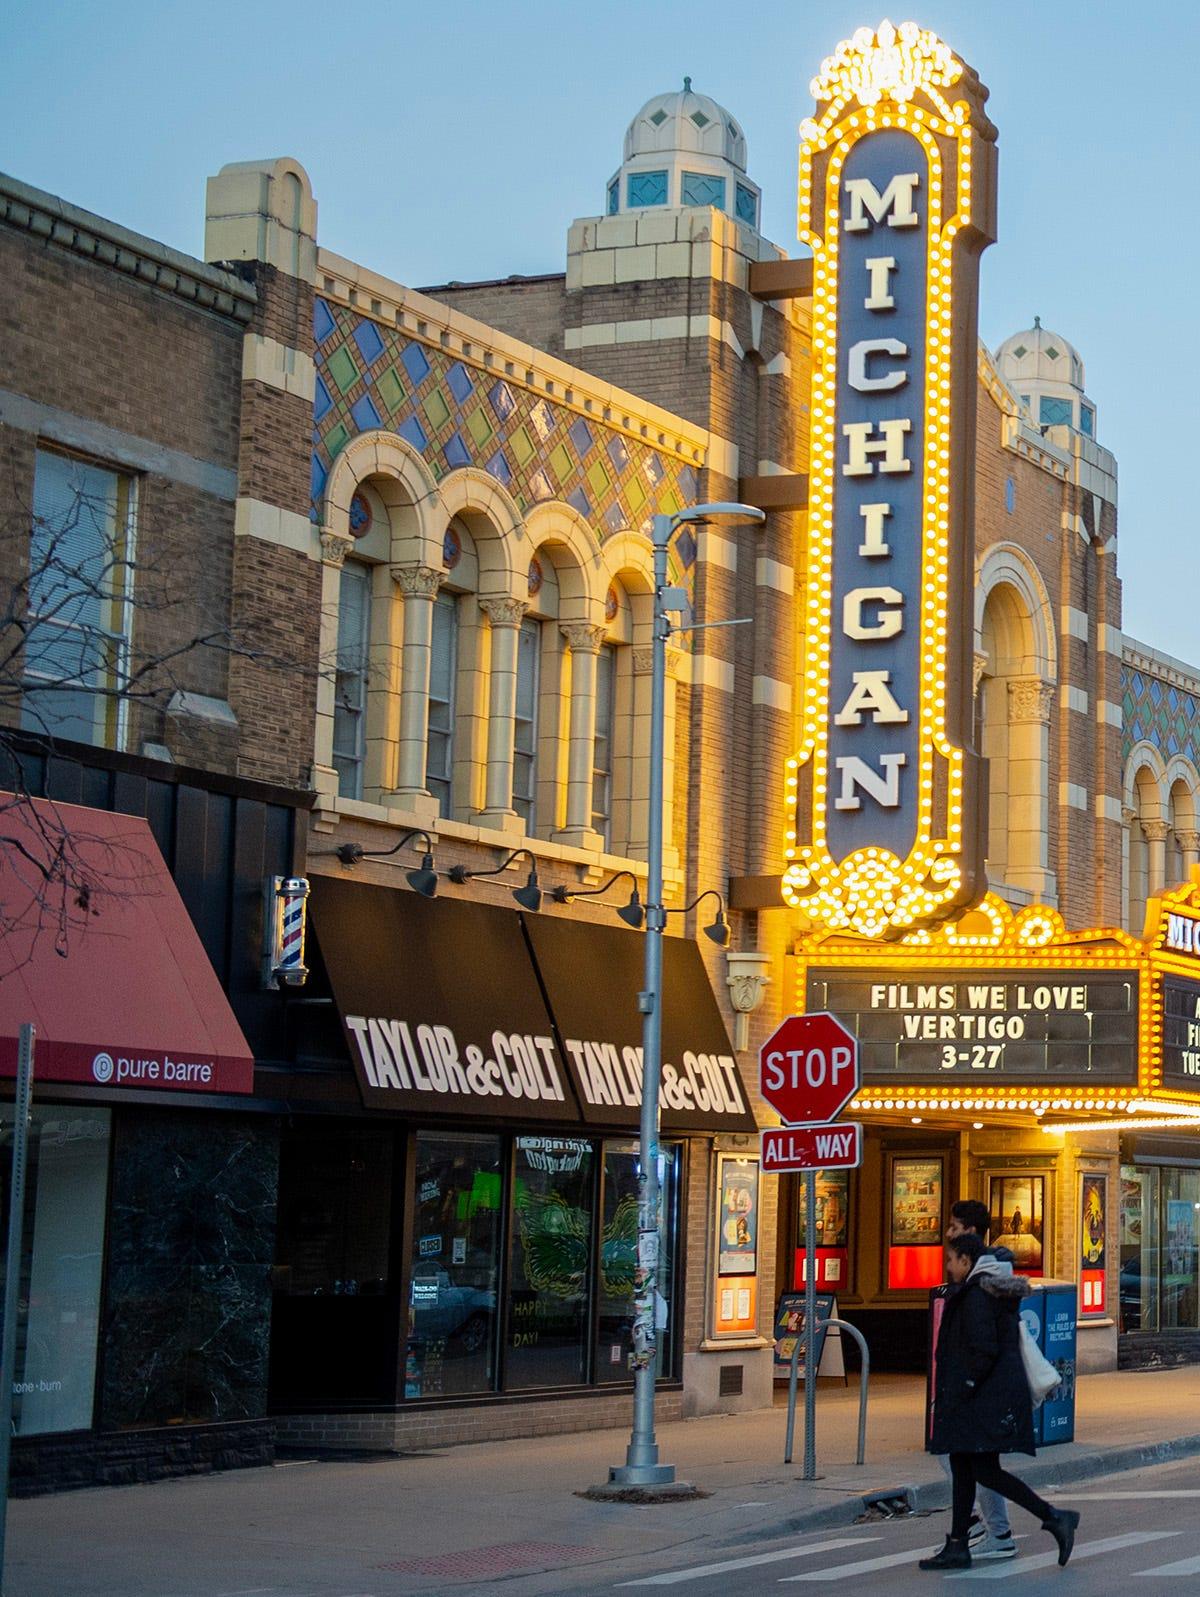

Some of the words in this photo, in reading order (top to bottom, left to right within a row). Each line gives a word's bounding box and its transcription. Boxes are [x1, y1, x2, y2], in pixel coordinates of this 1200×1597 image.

[834, 173, 919, 810] MICHIGAN
[871, 985, 955, 1010] FILMS
[968, 986, 1005, 1010] WE
[1017, 986, 1085, 1010] LOVE
[904, 1015, 1025, 1039] VERTIGO
[117, 1058, 160, 1082] pure
[164, 1056, 212, 1082] barre
[765, 1046, 852, 1091] STOP
[941, 1045, 1002, 1069] 3-27
[765, 1137, 802, 1163] ALL
[815, 1133, 853, 1159] WAY
[514, 1298, 547, 1316] HAPPY
[1049, 1331, 1073, 1342] RECYCLING
